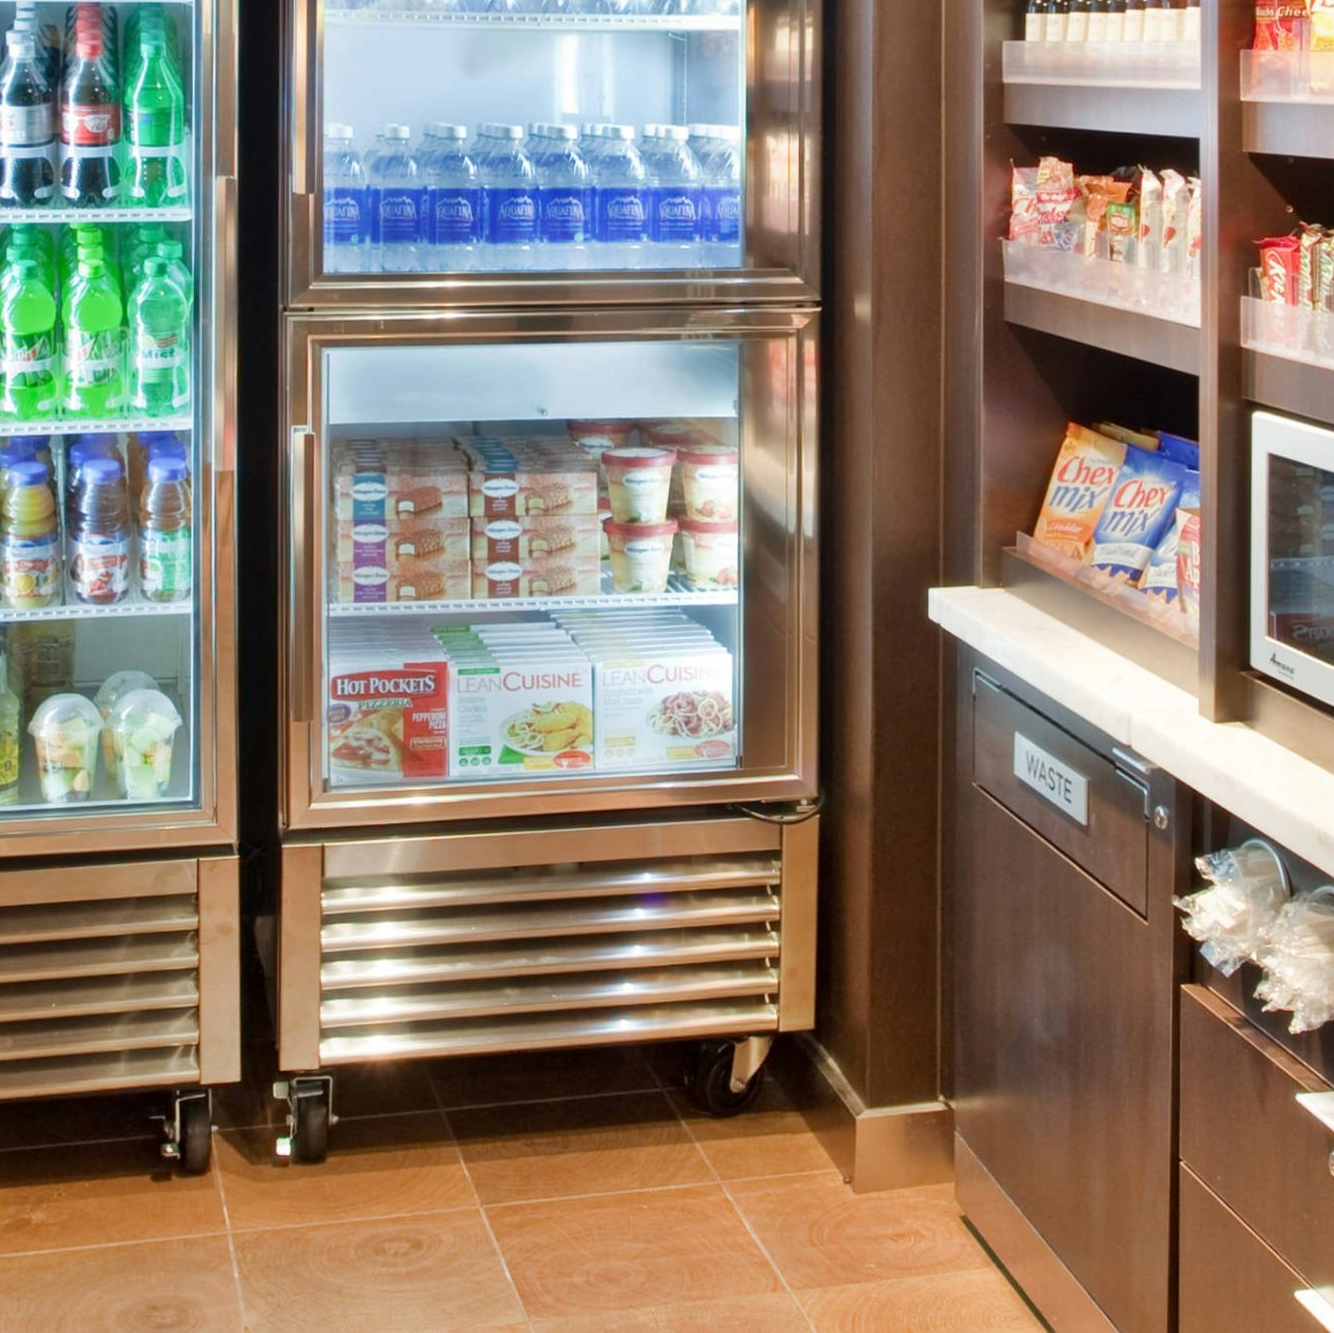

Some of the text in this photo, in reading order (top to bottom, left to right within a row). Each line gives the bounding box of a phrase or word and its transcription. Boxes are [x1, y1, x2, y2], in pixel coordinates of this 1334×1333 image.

[1277, 6, 1308, 17] Chee
[1057, 455, 1118, 486] Chex
[1049, 485, 1110, 513] mix
[1113, 478, 1173, 509] Chex
[1103, 509, 1160, 537] mix
[336, 674, 437, 695] HOT POCKETS
[457, 671, 582, 693] LEAN CUISINE
[602, 669, 647, 687] LEAN
[358, 697, 413, 710] PIZZERIA
[1025, 750, 1073, 804] WASTE
